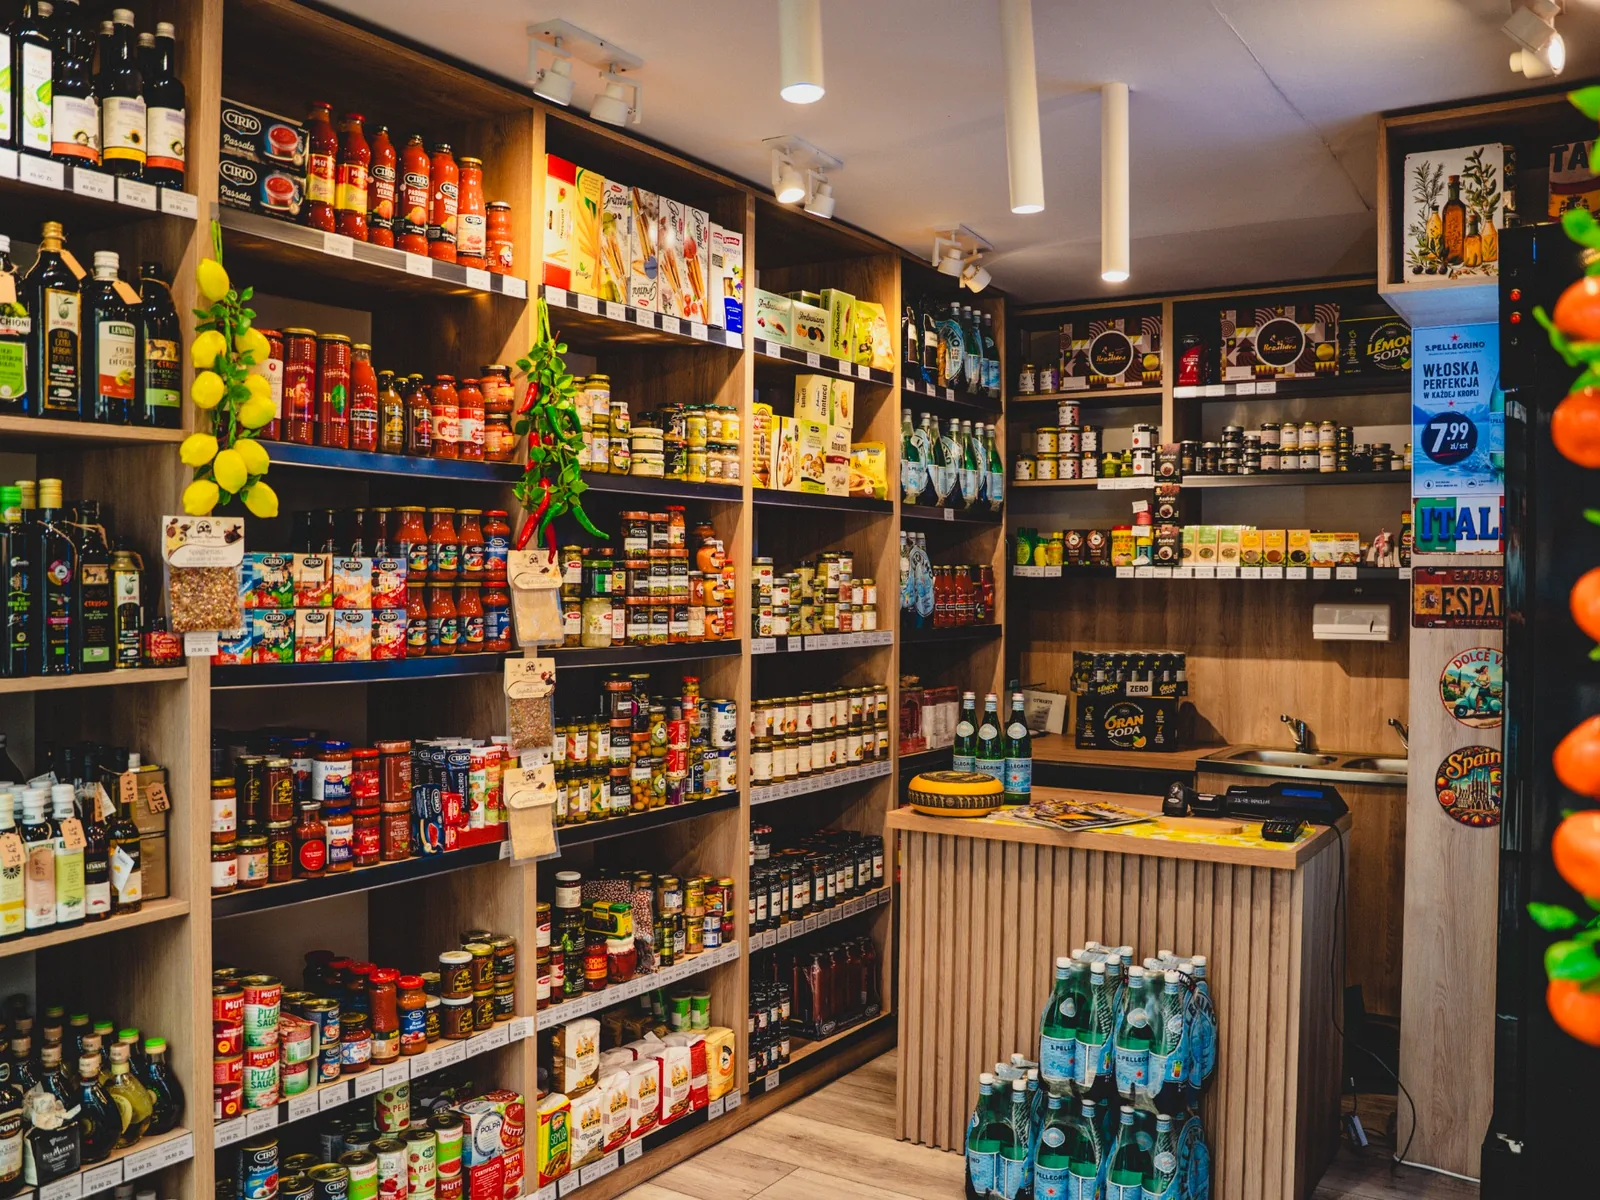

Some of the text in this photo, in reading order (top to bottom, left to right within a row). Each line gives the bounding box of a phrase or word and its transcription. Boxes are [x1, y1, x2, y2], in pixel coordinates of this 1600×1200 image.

[226, 112, 258, 131] CIRIO
[223, 133, 255, 151] Passata
[222, 163, 254, 182] CIRIO
[220, 185, 252, 202] Passata
[1425, 341, 1486, 352] S.PELLEGRINO
[1373, 346, 1410, 363] SODA
[1423, 360, 1479, 378] WŁOSKA
[1423, 376, 1480, 391] PERFEKCJA
[1423, 389, 1479, 399] W KAŻDEJ KROPLI
[1430, 422, 1469, 453] 7.99
[263, 557, 283, 566] CIRIO
[304, 557, 322, 566] CIRIO
[345, 562, 361, 570] CIRIO
[381, 562, 397, 570] CIRIO
[265, 613, 284, 622] CIRIO
[306, 613, 324, 622] CIRIO
[346, 613, 362, 622] CIRIO
[381, 613, 397, 621] CIRIO
[1453, 651, 1491, 670] DOLCE
[1129, 685, 1149, 693] ZERO
[1105, 714, 1144, 731] ORAN
[1107, 726, 1141, 739] SODA
[1446, 750, 1501, 780] Spain
[86, 861, 107, 871] LEVANTE
[261, 987, 280, 998] MUTTI
[225, 1000, 244, 1010] MUT
[252, 1050, 275, 1061] MUTTI
[250, 1067, 276, 1081] PIZZA
[251, 1078, 276, 1089] SAUCE
[672, 1076, 688, 1087] CAPUTO
[639, 1087, 657, 1098] CAPUTO
[610, 1102, 628, 1113] CAPUTO
[0, 1120, 21, 1133] PONTI
[480, 1120, 501, 1134] POLPA
[503, 1124, 524, 1136] MUTTI
[504, 1154, 520, 1164] MUTTI
